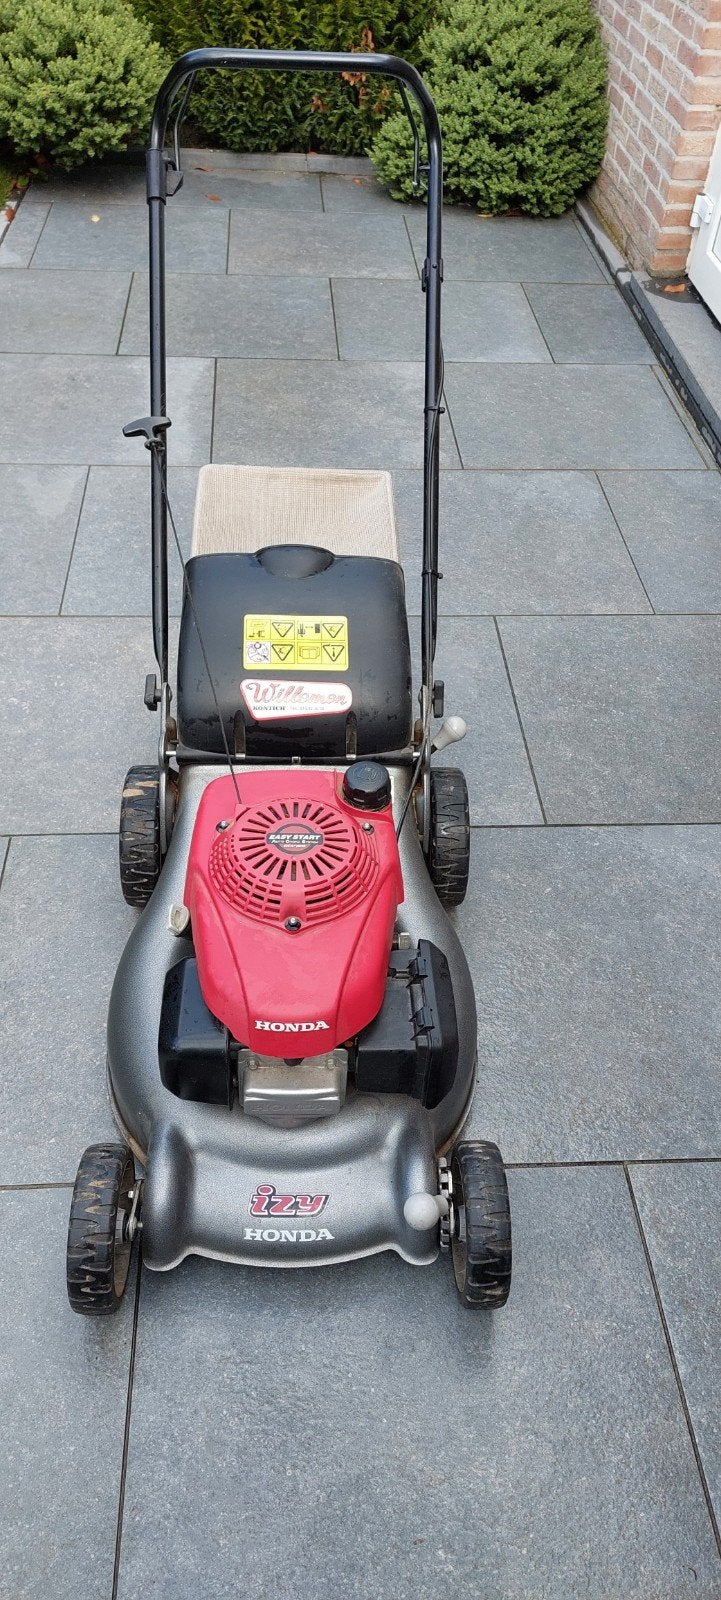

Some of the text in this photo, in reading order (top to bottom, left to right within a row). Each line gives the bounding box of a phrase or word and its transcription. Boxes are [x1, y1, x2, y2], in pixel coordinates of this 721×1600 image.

[254, 1020, 330, 1032] HONDA
[250, 1184, 330, 1217] izy
[243, 1228, 336, 1242] HONDA
